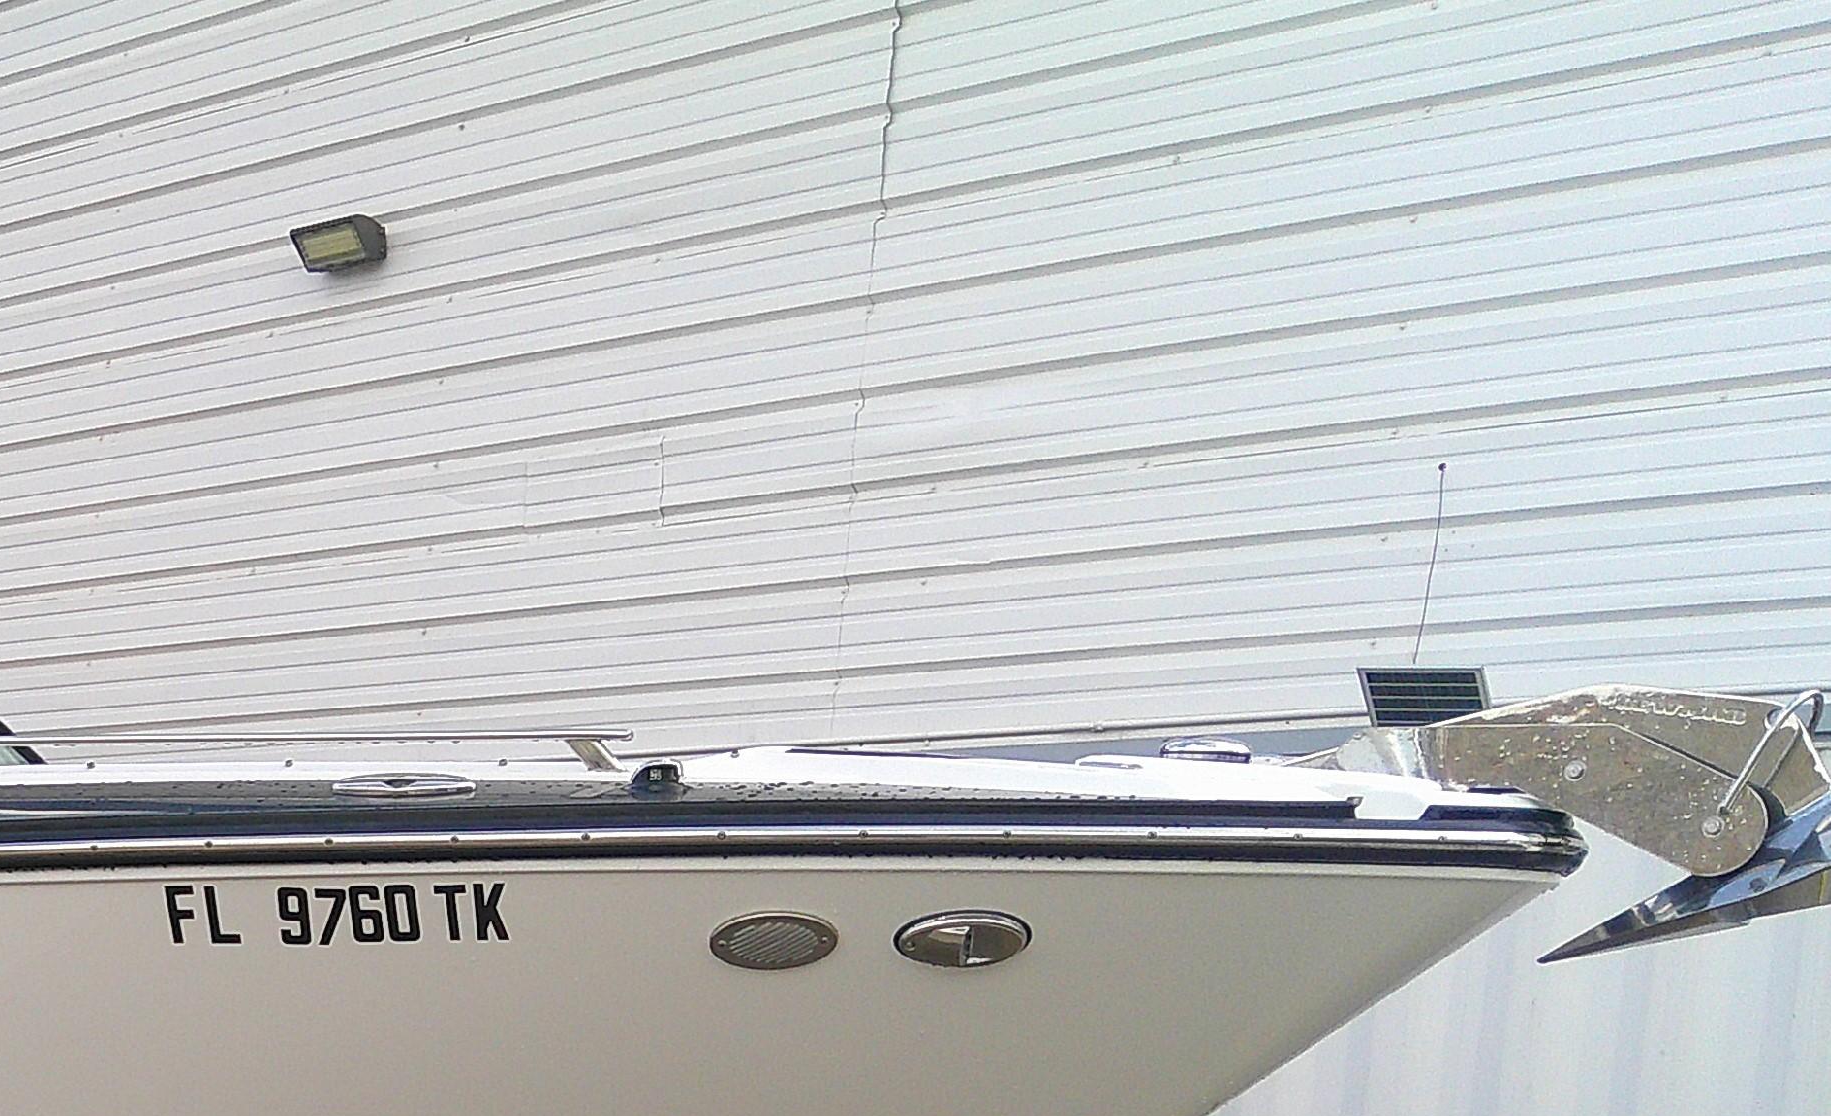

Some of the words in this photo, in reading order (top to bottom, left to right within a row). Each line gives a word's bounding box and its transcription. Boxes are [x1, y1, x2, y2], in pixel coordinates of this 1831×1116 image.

[164, 885, 242, 944] FL
[276, 885, 421, 946] 9760
[432, 882, 510, 942] TK
